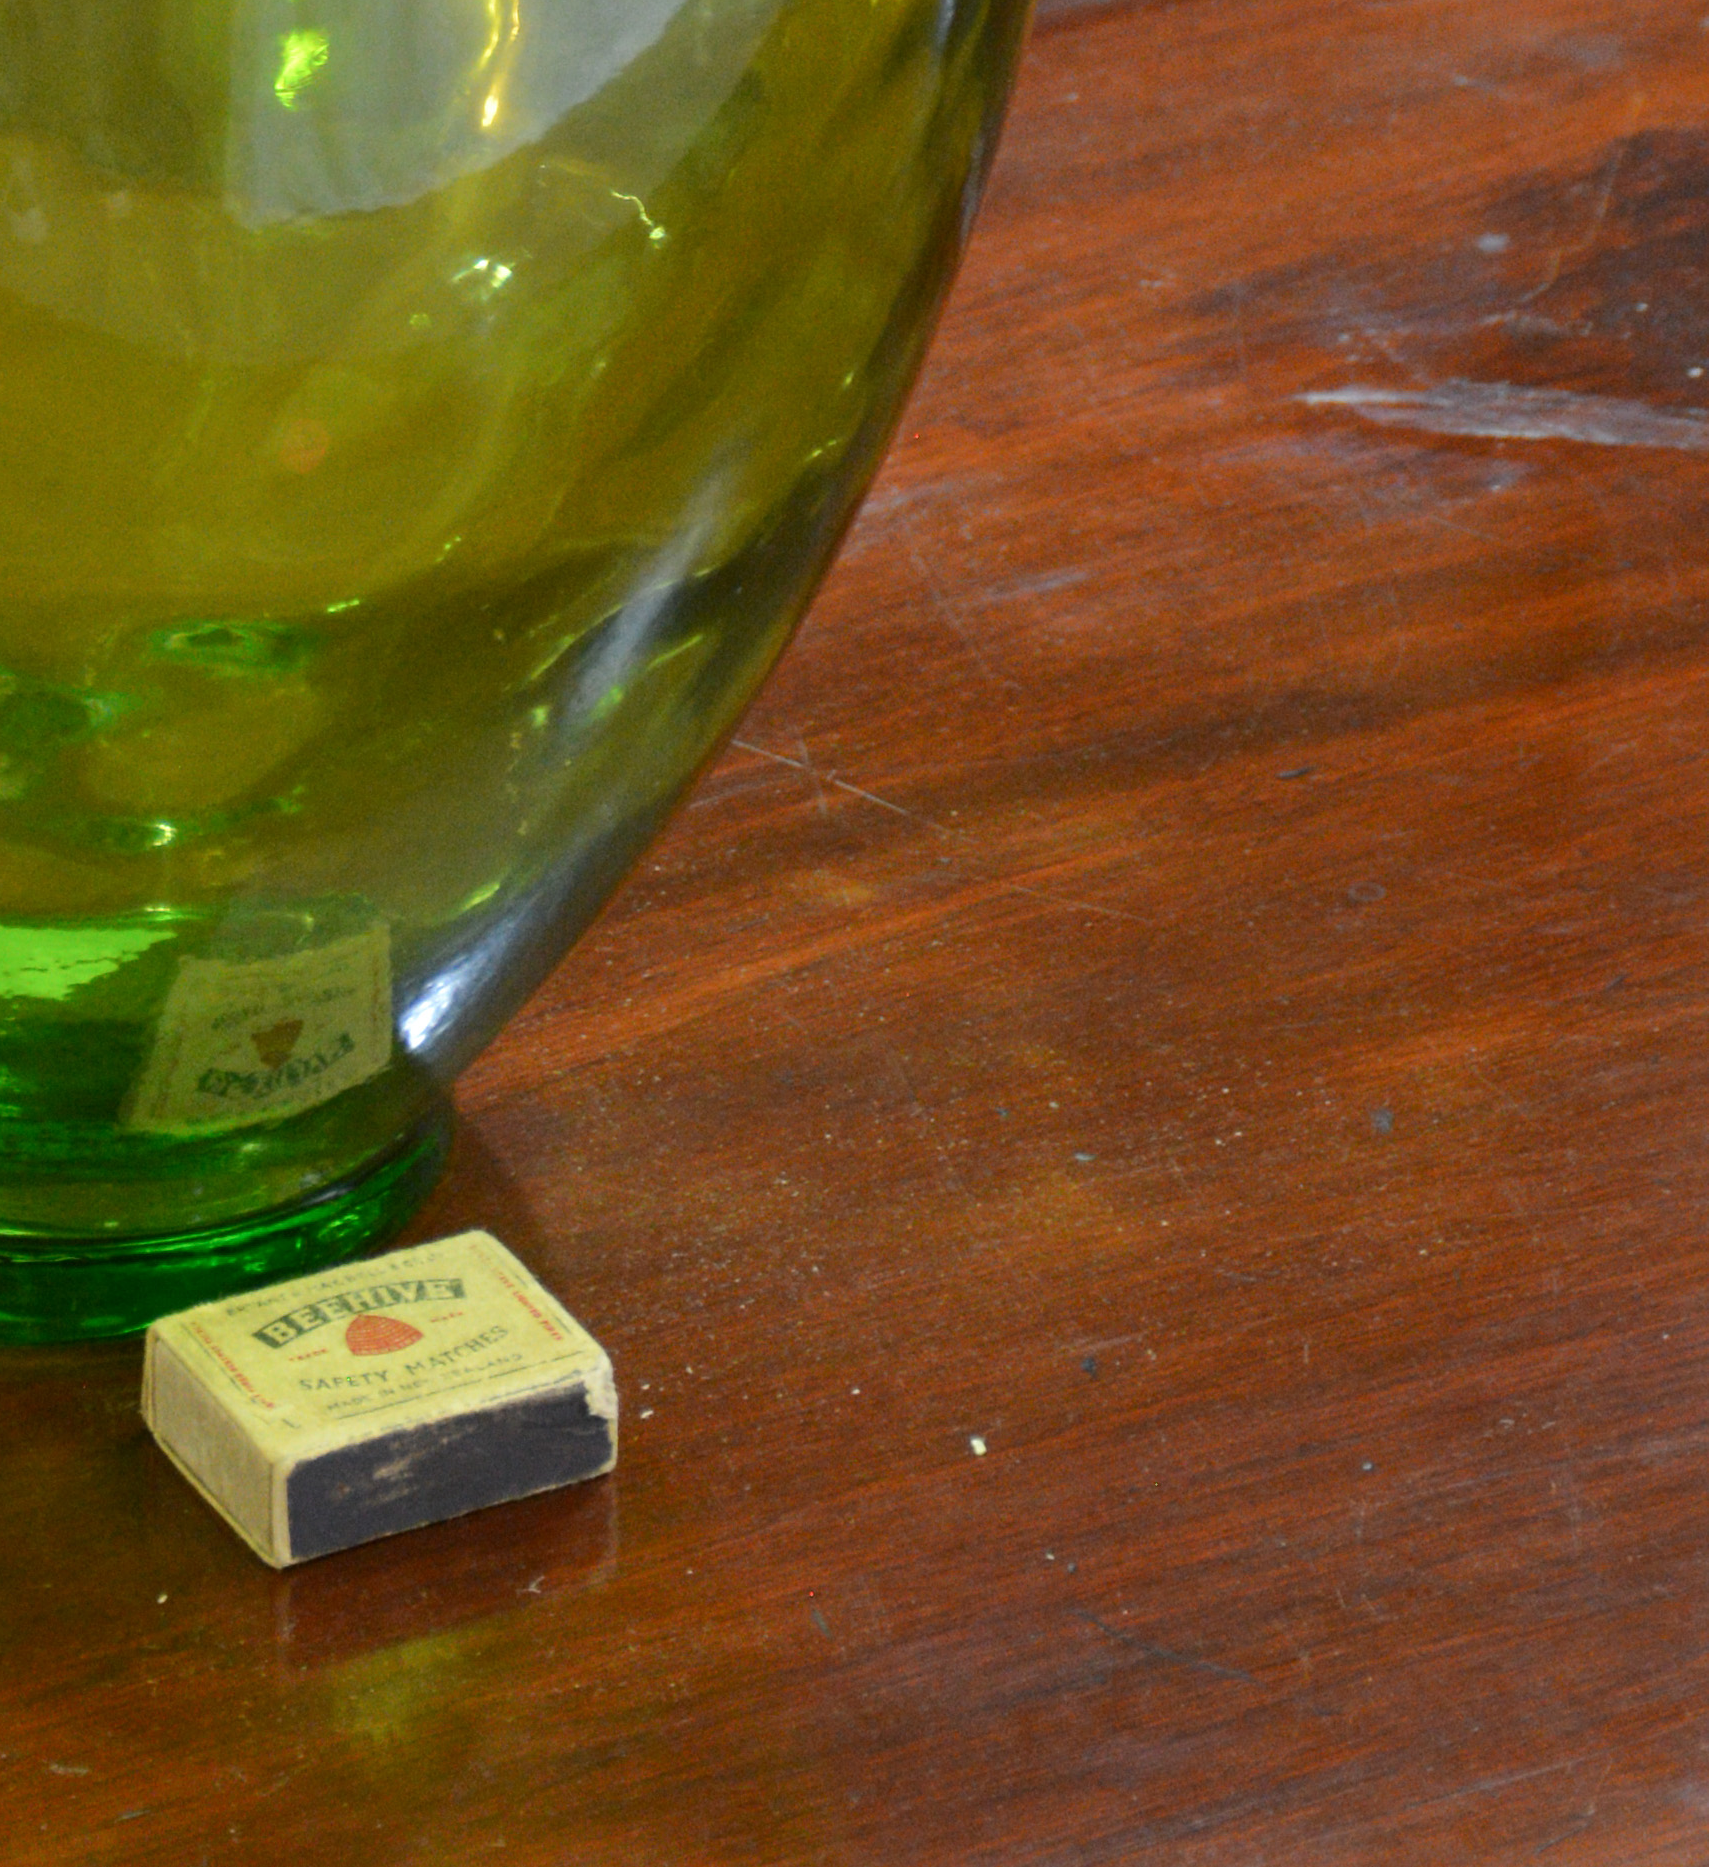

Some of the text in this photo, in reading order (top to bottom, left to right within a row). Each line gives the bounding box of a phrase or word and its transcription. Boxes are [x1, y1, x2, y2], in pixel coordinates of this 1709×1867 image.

[259, 1279, 455, 1347] BEEHIVE
[299, 1325, 509, 1391] SAFETY MATCHES
